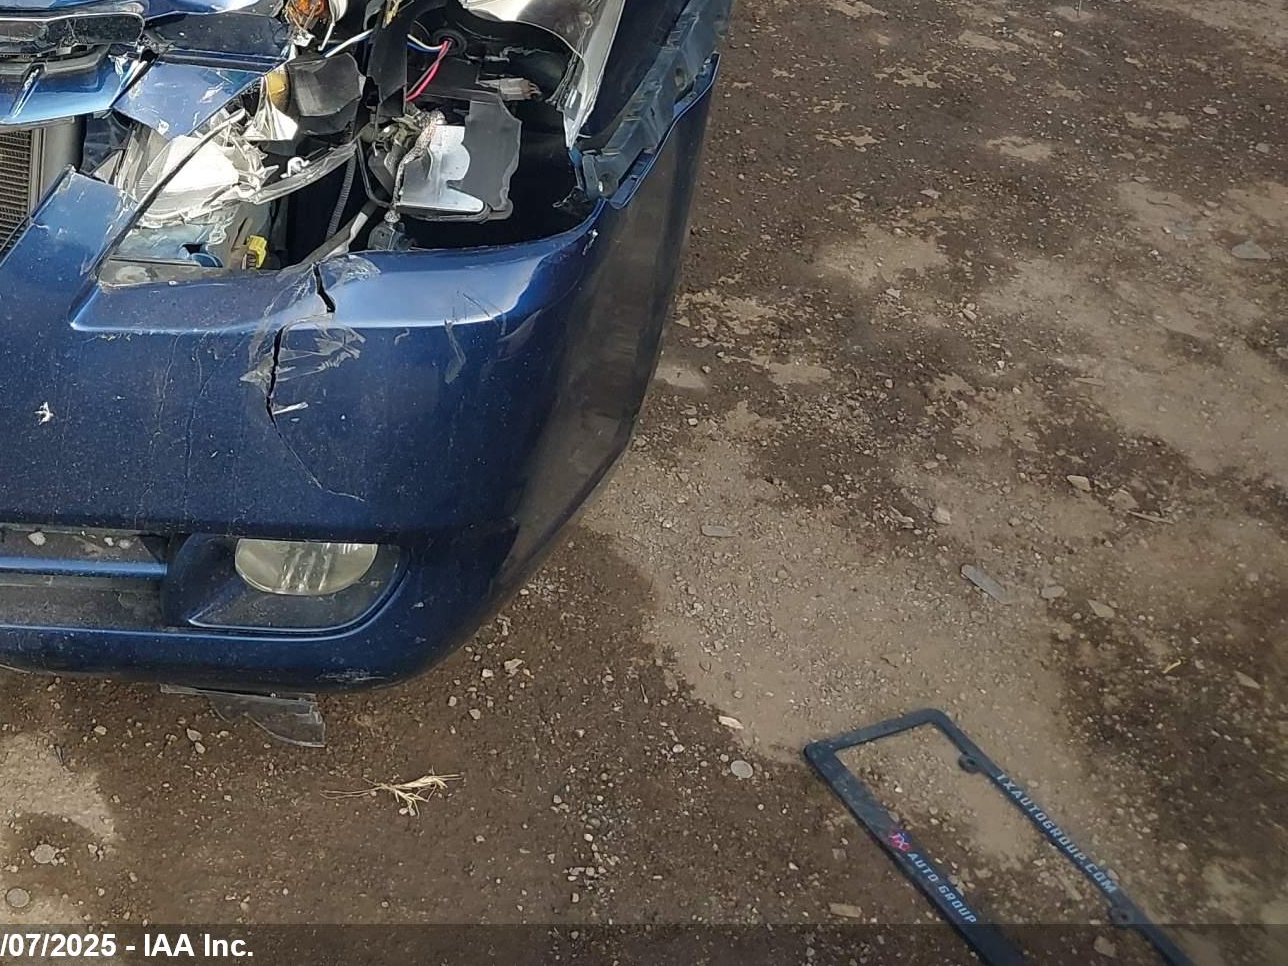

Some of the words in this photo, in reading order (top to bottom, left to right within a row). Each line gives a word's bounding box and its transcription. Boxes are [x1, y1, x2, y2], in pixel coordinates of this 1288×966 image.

[996, 773, 1118, 894] TXAUTOGROUP.COM
[907, 852, 940, 883] AUTO
[938, 884, 977, 923] GROUP
